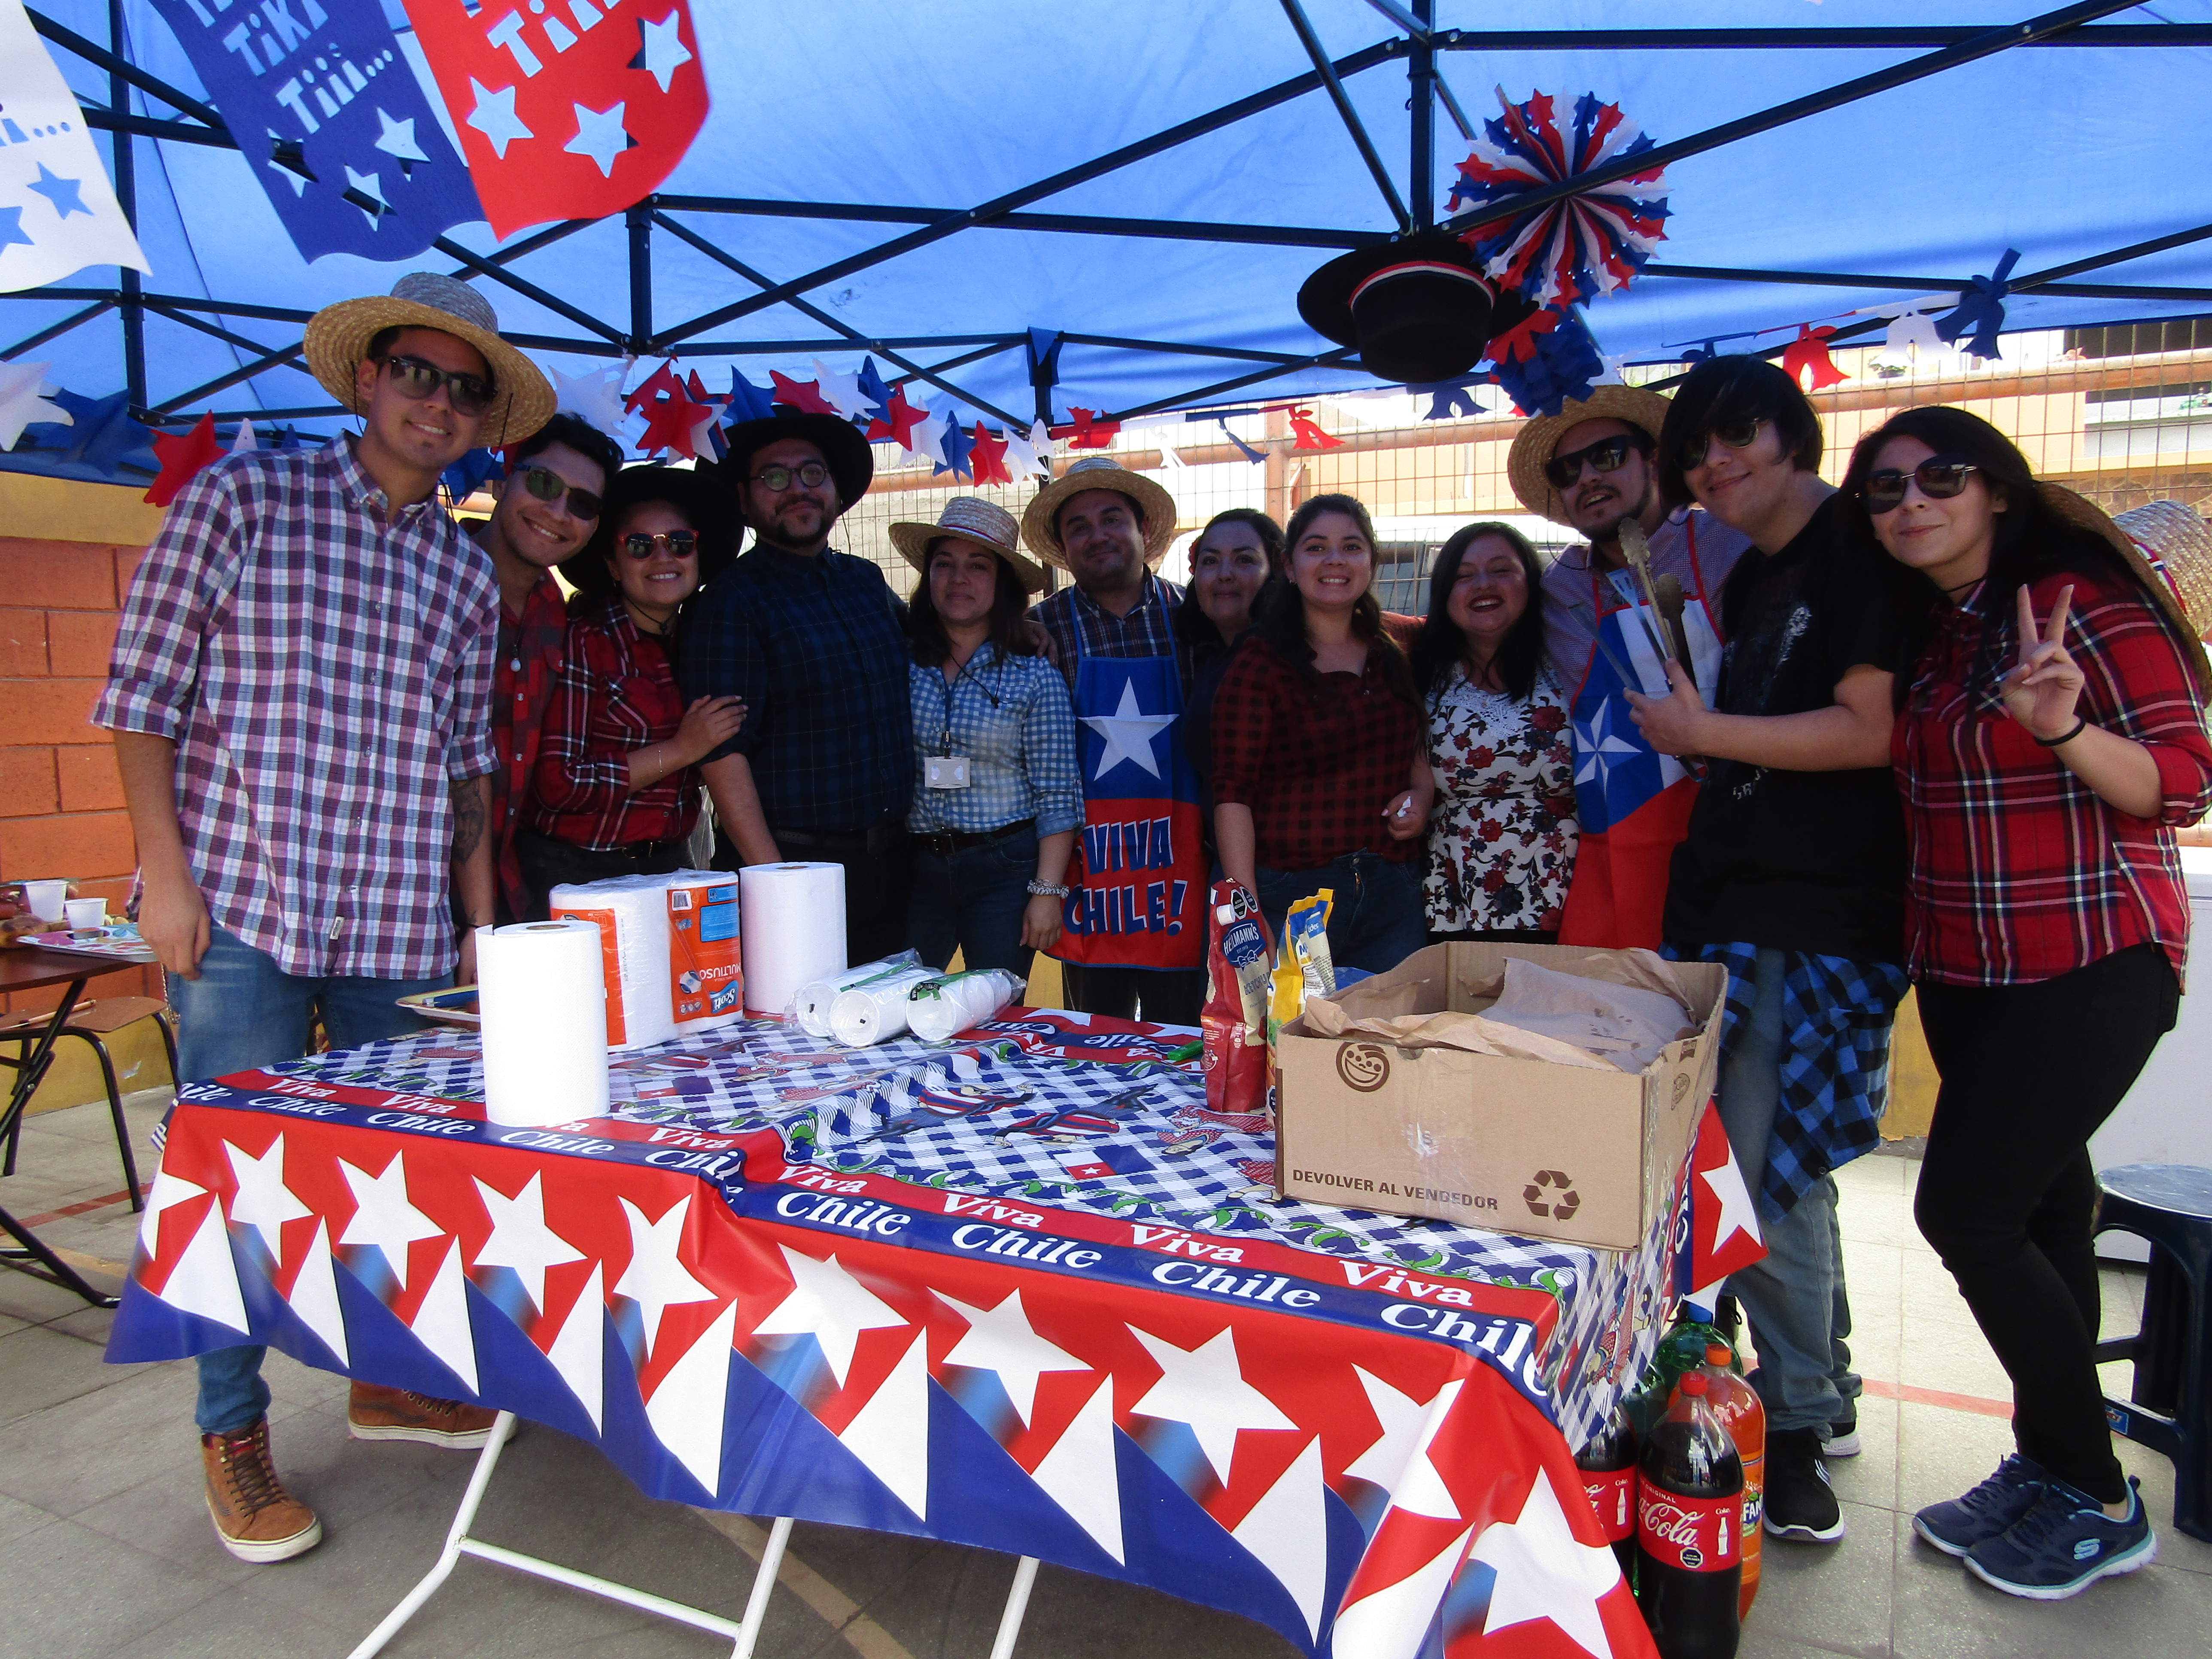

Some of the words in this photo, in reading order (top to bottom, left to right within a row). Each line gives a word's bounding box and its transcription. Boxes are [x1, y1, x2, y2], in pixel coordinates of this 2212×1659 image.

[1063, 879, 1188, 937] CHILE!
[699, 962, 741, 980] MULTIUSO
[714, 988, 735, 1011] Scott
[248, 1096, 347, 1116] Chile
[366, 1112, 476, 1134] Chile
[500, 1130, 616, 1155] Chile
[776, 1192, 911, 1236] Chile
[951, 1224, 1103, 1268] Chile
[1152, 1261, 1322, 1307] Chile
[266, 1078, 337, 1097] Viva
[380, 1094, 457, 1114] Viva
[647, 1127, 735, 1149] Viva
[776, 1165, 868, 1194] Viva
[943, 1193, 1045, 1228] Viva
[1130, 1224, 1245, 1263] Viva
[1338, 1260, 1473, 1307] Viva
[1292, 1169, 1374, 1192] DEVOLVER
[1378, 1182, 1399, 1196] AL
[1404, 1185, 1498, 1210] VENDEDOR
[1645, 1484, 1677, 1503] ORIGINAL
[1742, 1493, 1763, 1521] FAN
